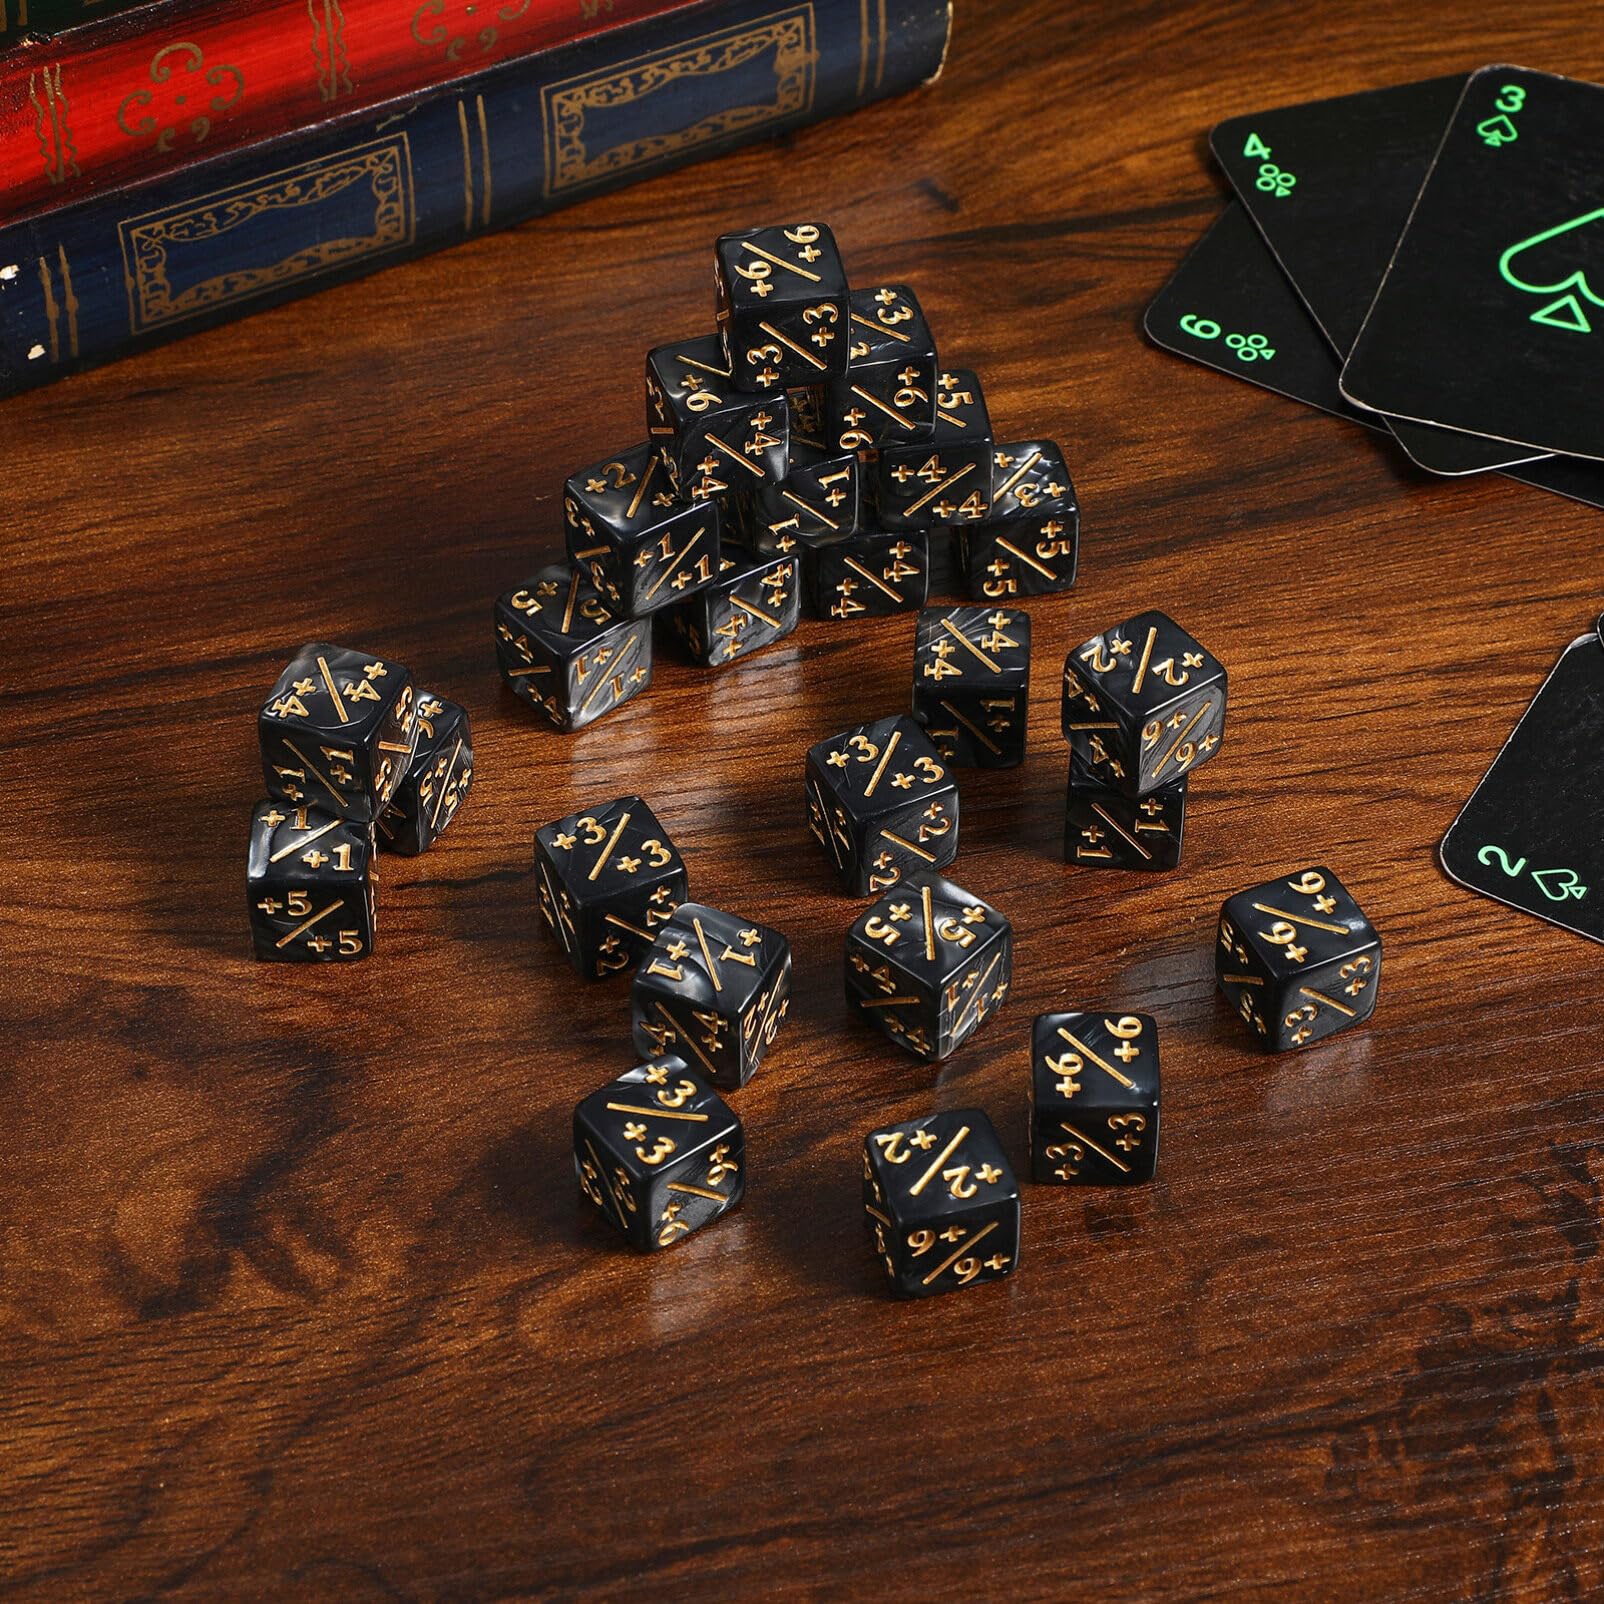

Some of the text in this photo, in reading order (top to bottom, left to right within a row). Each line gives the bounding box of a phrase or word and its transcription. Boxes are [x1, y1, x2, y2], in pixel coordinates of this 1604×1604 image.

[1495, 85, 1527, 113] 3
[1242, 132, 1273, 161] 4
[1179, 314, 1222, 340] 6
[1477, 845, 1527, 878] 2
